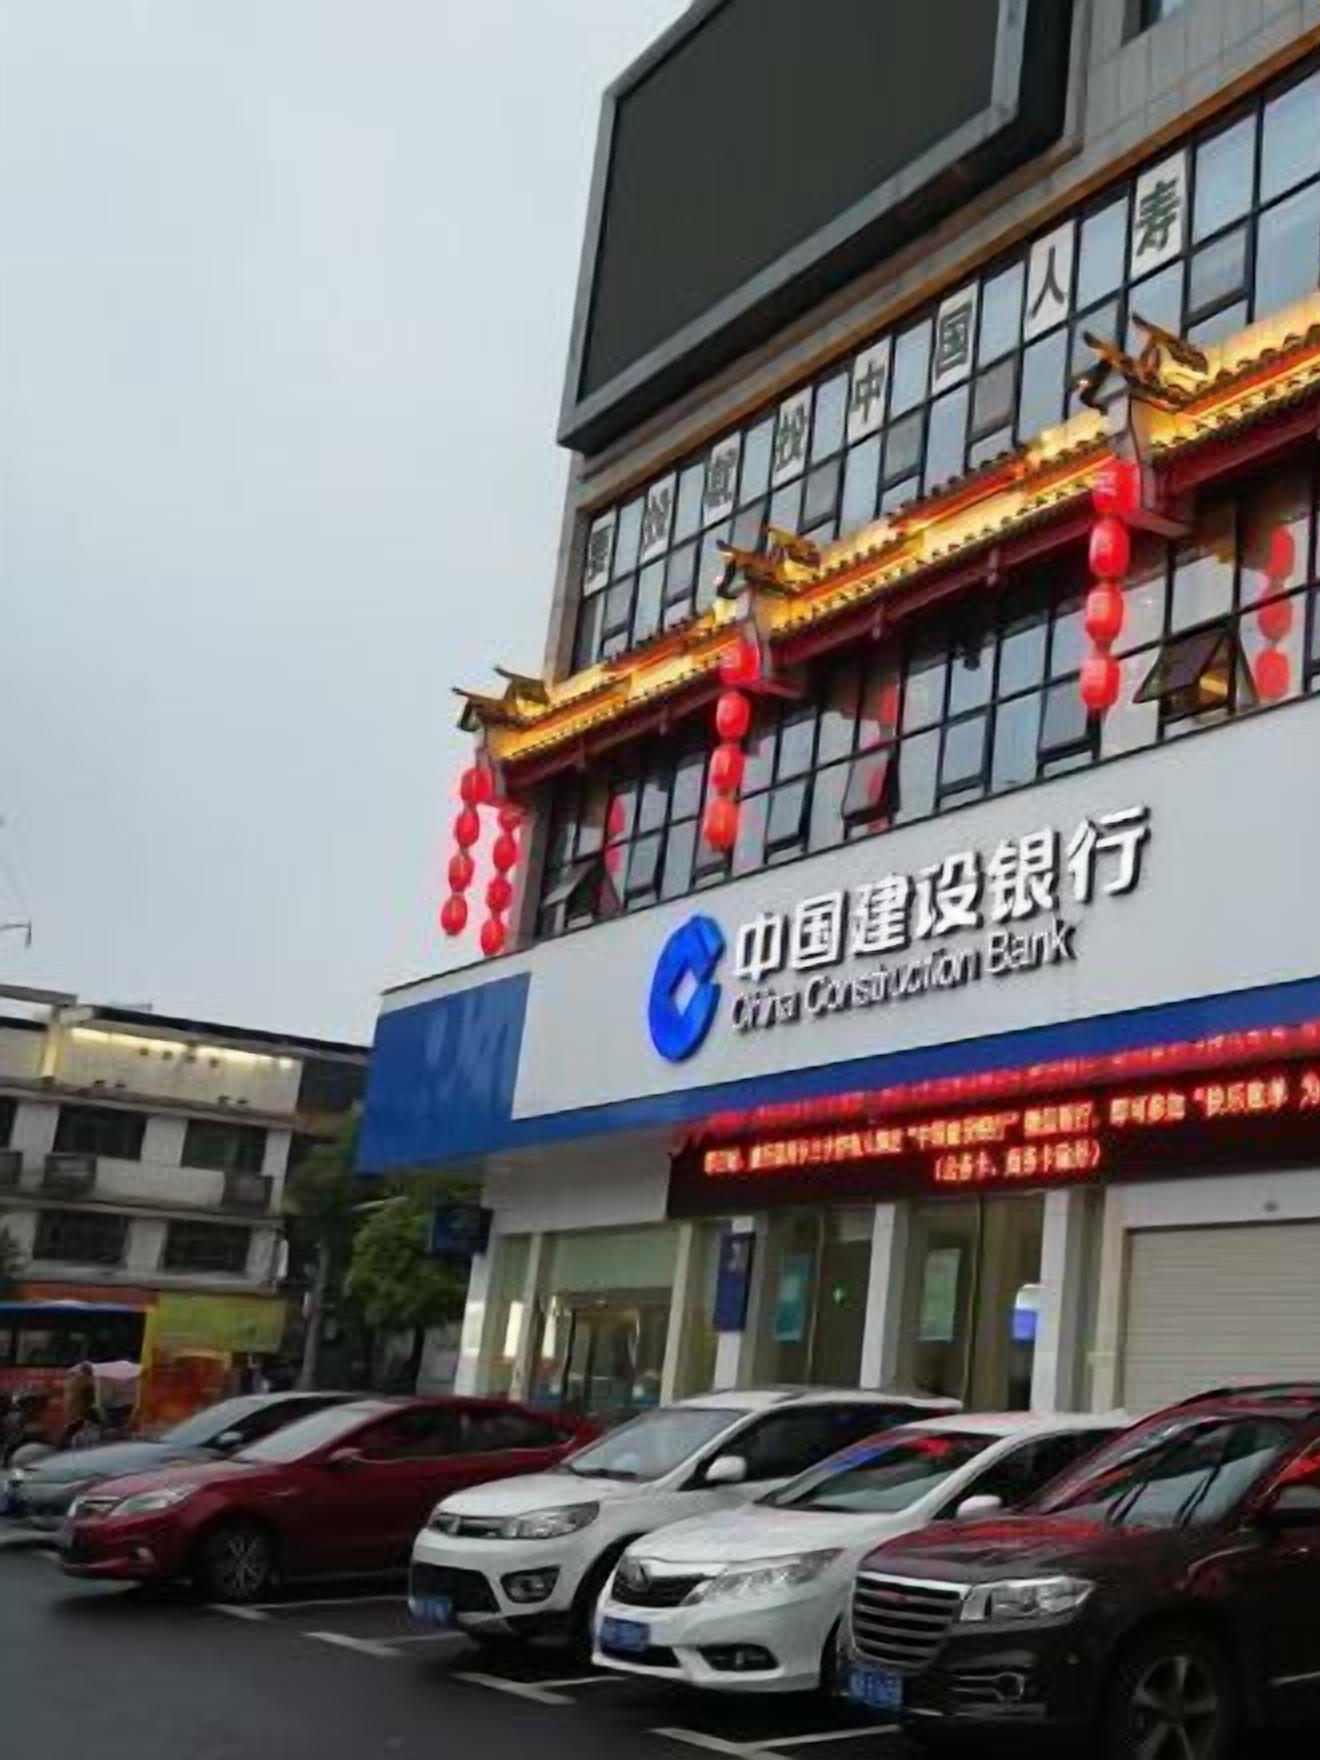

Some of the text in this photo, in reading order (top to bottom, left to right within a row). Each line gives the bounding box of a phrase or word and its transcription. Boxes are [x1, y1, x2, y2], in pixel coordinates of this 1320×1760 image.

[734, 804, 1149, 982] 中国建设银行
[731, 917, 1077, 1032] China Construction Bank
